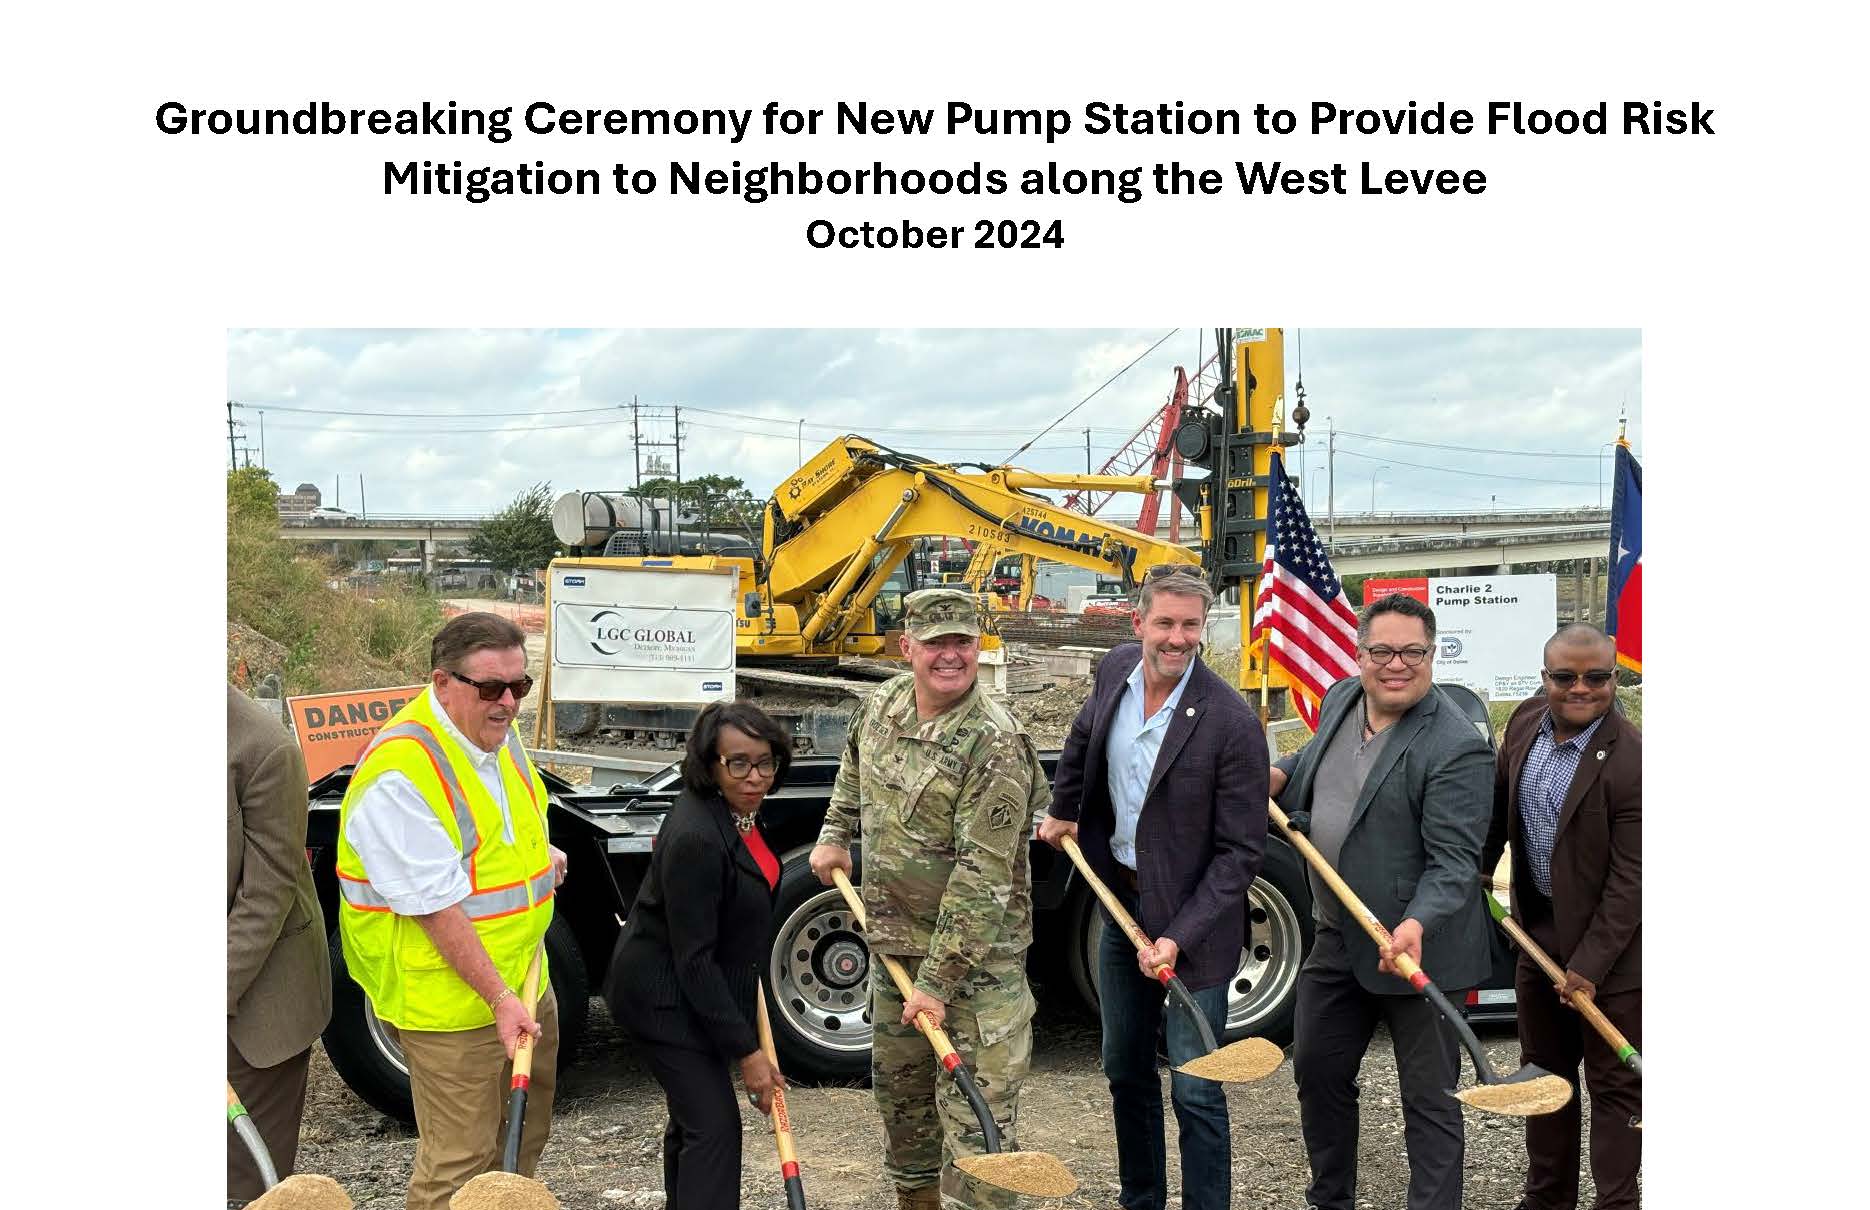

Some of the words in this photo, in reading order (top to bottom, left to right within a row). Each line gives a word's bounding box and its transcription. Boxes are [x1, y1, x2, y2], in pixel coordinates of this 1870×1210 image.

[968, 524, 1010, 543] 210583
[1020, 515, 1138, 568] KOMAU
[1436, 584, 1481, 594] Charlie
[1484, 584, 1493, 593] 2
[1436, 597, 1471, 607] Pump
[1474, 595, 1518, 605] Station
[597, 627, 631, 641] LGC
[634, 629, 696, 644] GLOBAL
[304, 696, 418, 728] DANGE
[938, 754, 959, 769] ARMY
